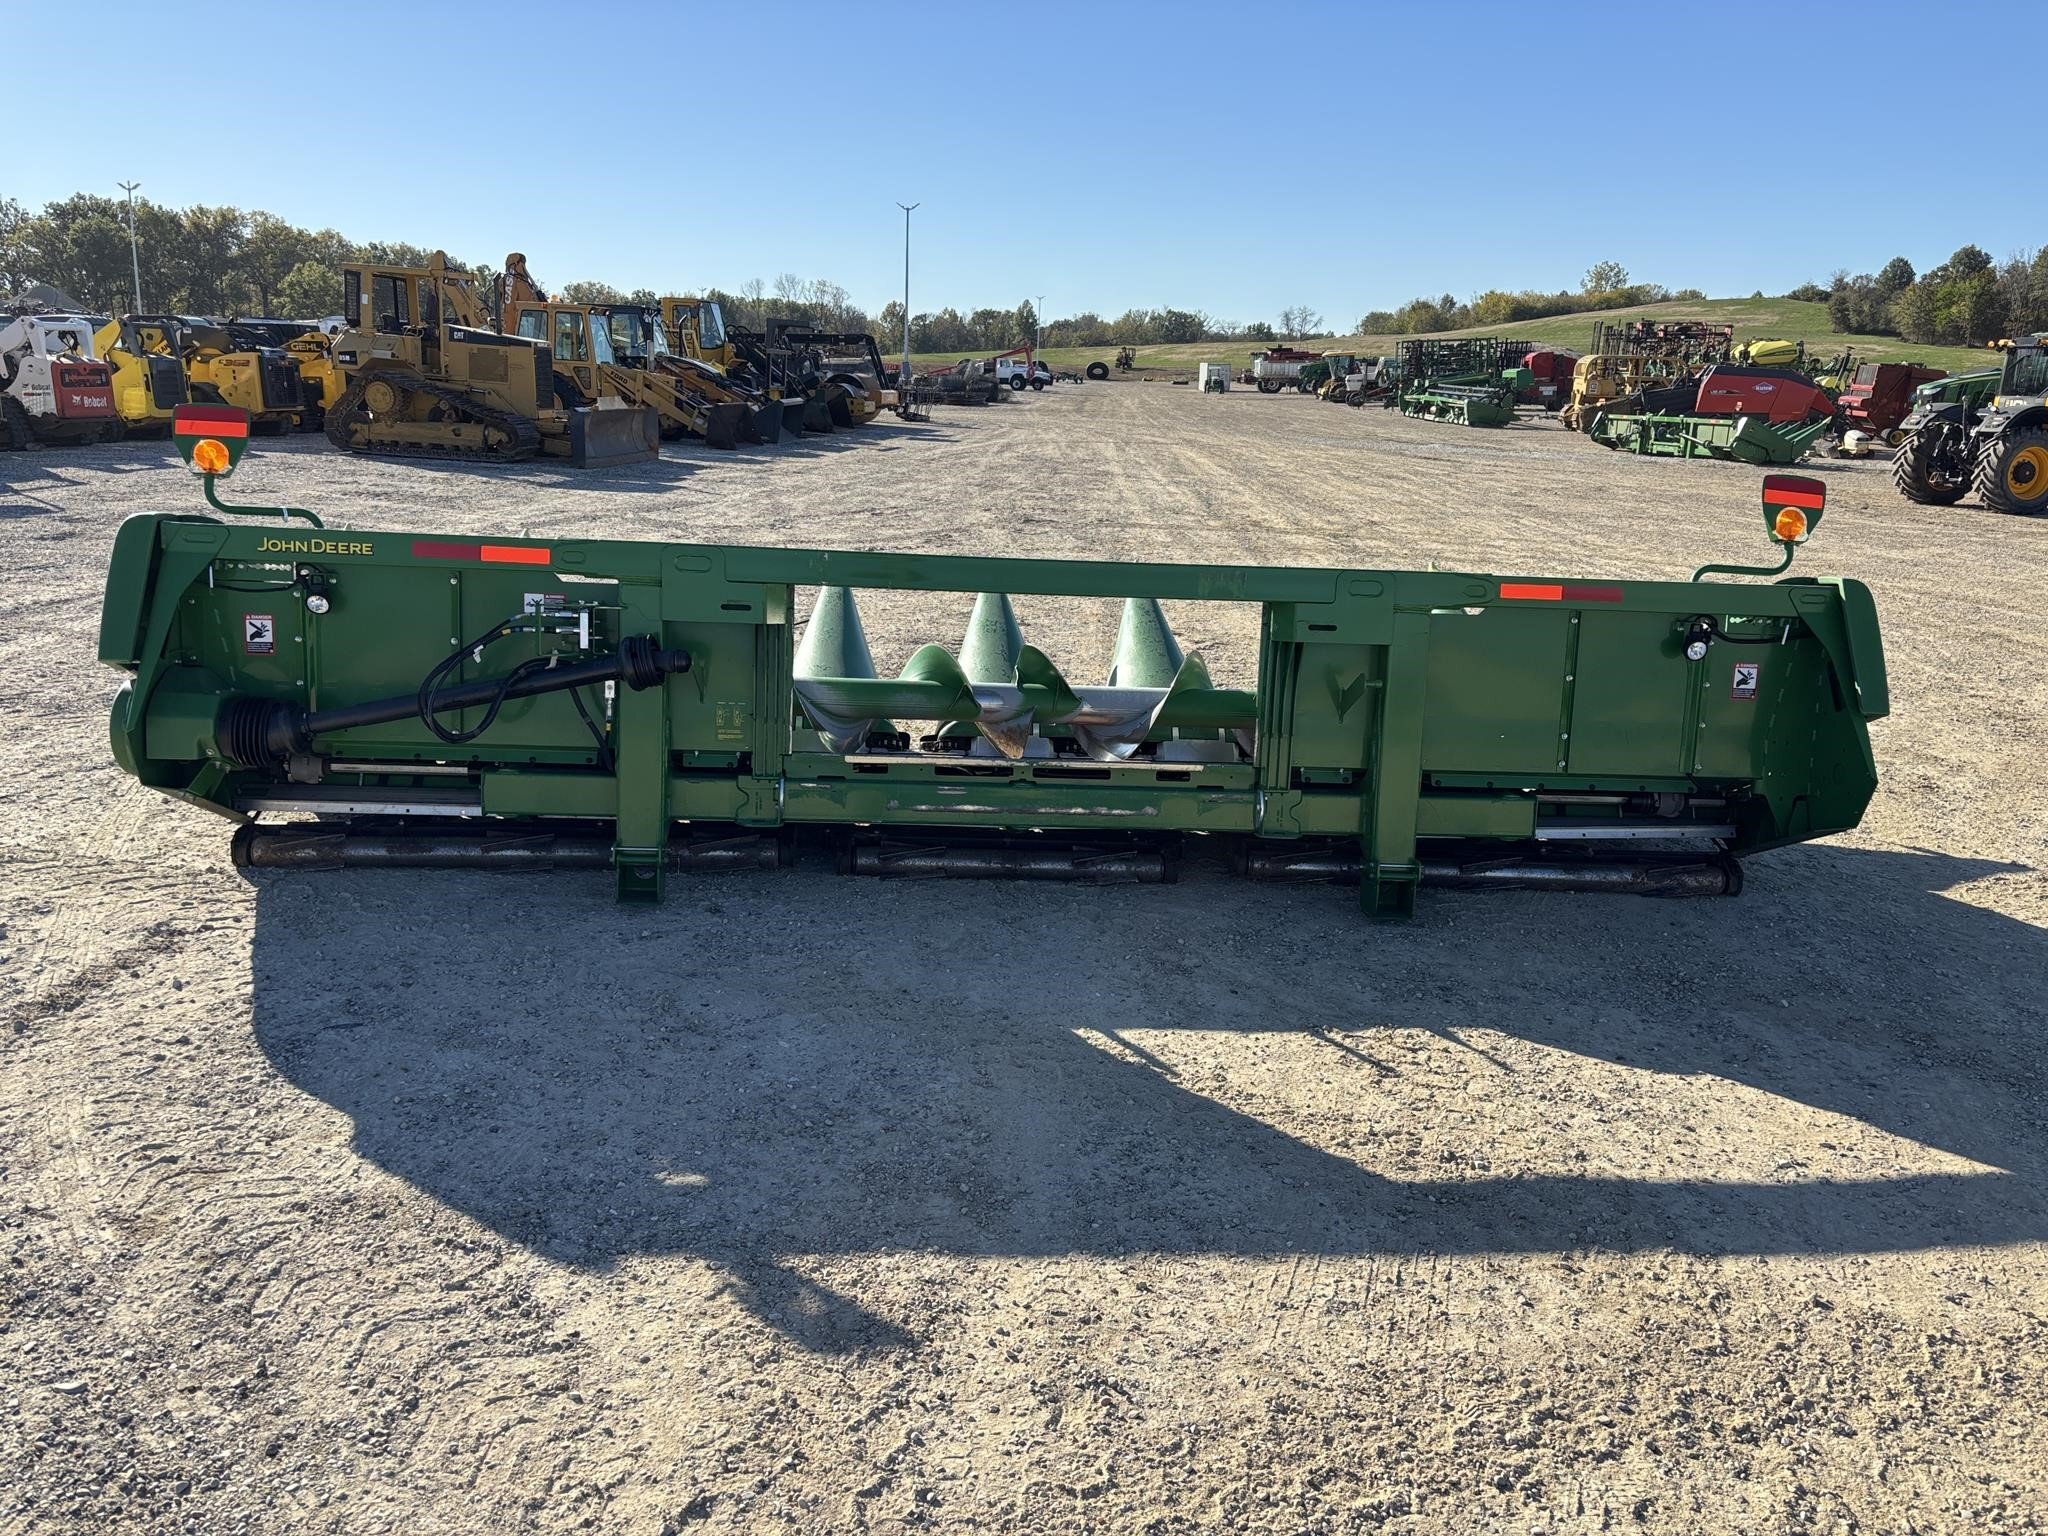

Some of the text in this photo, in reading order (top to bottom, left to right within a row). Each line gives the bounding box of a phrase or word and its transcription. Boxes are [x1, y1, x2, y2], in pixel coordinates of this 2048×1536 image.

[290, 342, 321, 351] GEHL
[610, 370, 629, 385] FORD
[83, 396, 107, 408] Bobcat
[257, 537, 373, 555] JOHN DEERE
